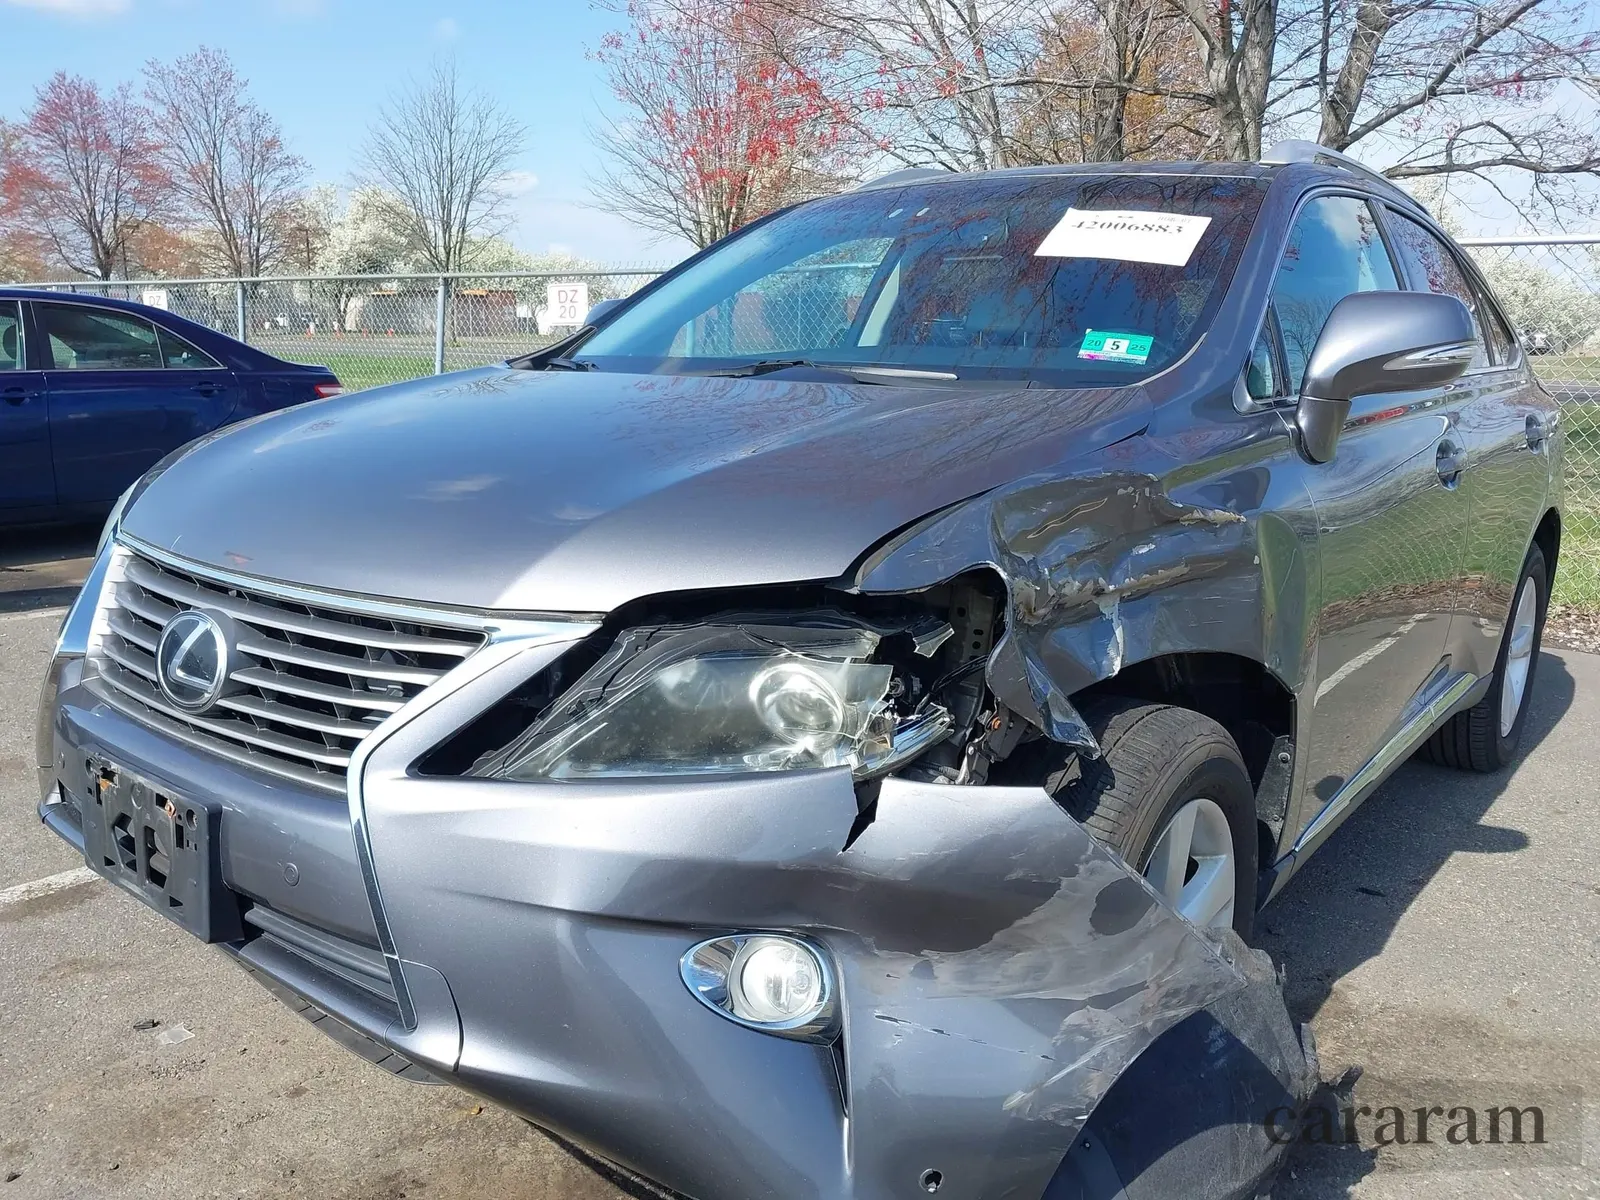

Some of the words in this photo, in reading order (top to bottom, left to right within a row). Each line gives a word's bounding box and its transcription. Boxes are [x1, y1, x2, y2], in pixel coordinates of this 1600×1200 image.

[148, 295, 163, 307] DZ
[557, 289, 579, 304] DZ
[559, 304, 577, 319] 20
[1086, 339, 1102, 348] 20
[1110, 340, 1122, 351] 5
[1130, 343, 1147, 352] 25
